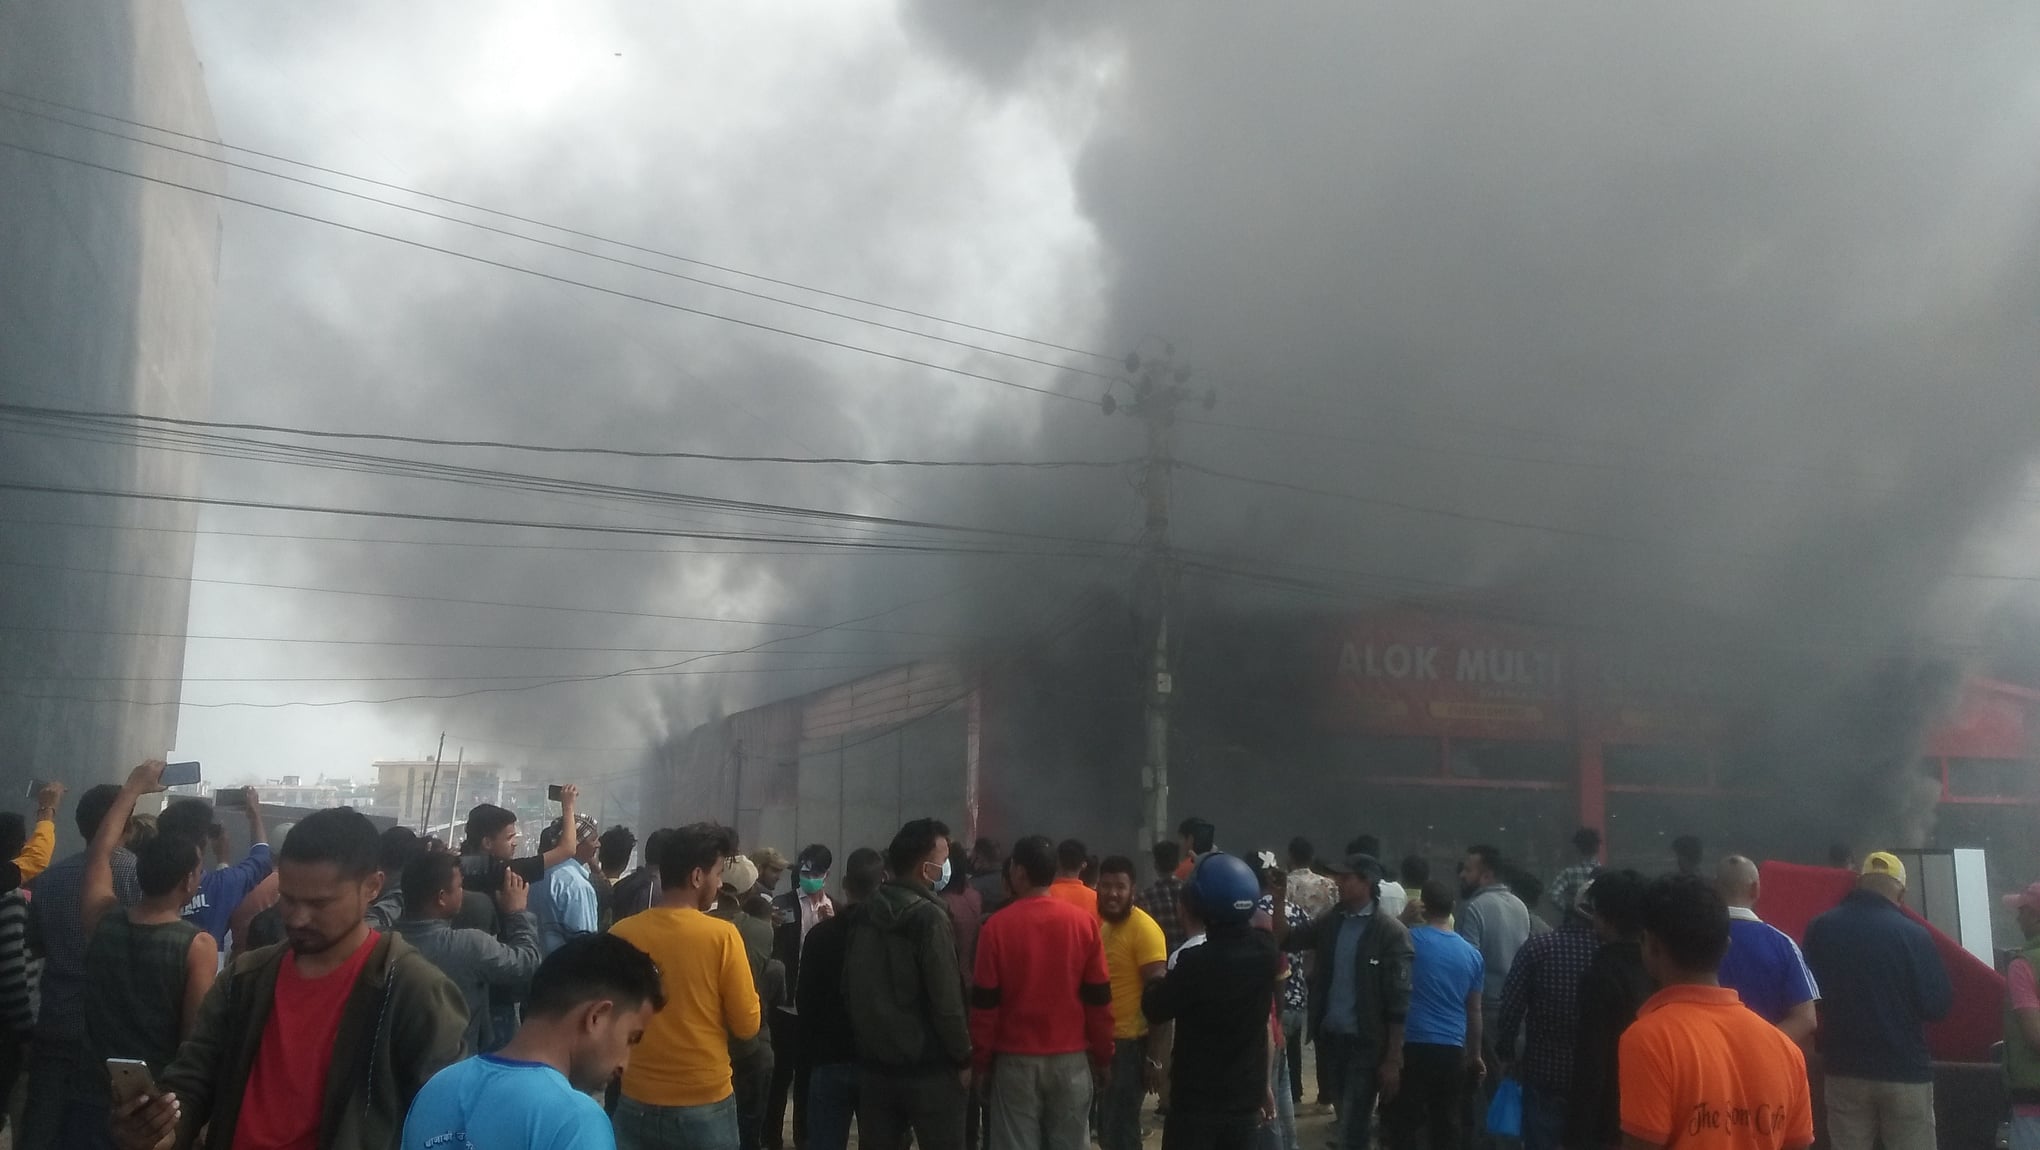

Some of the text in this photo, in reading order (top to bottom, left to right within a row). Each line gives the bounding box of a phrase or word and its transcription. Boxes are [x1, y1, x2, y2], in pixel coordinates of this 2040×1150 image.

[1337, 641, 1439, 681] ALOK
[1456, 647, 1562, 686] MULTI
[1688, 1102, 1721, 1136] The
[1756, 1103, 1786, 1135] Cfe
